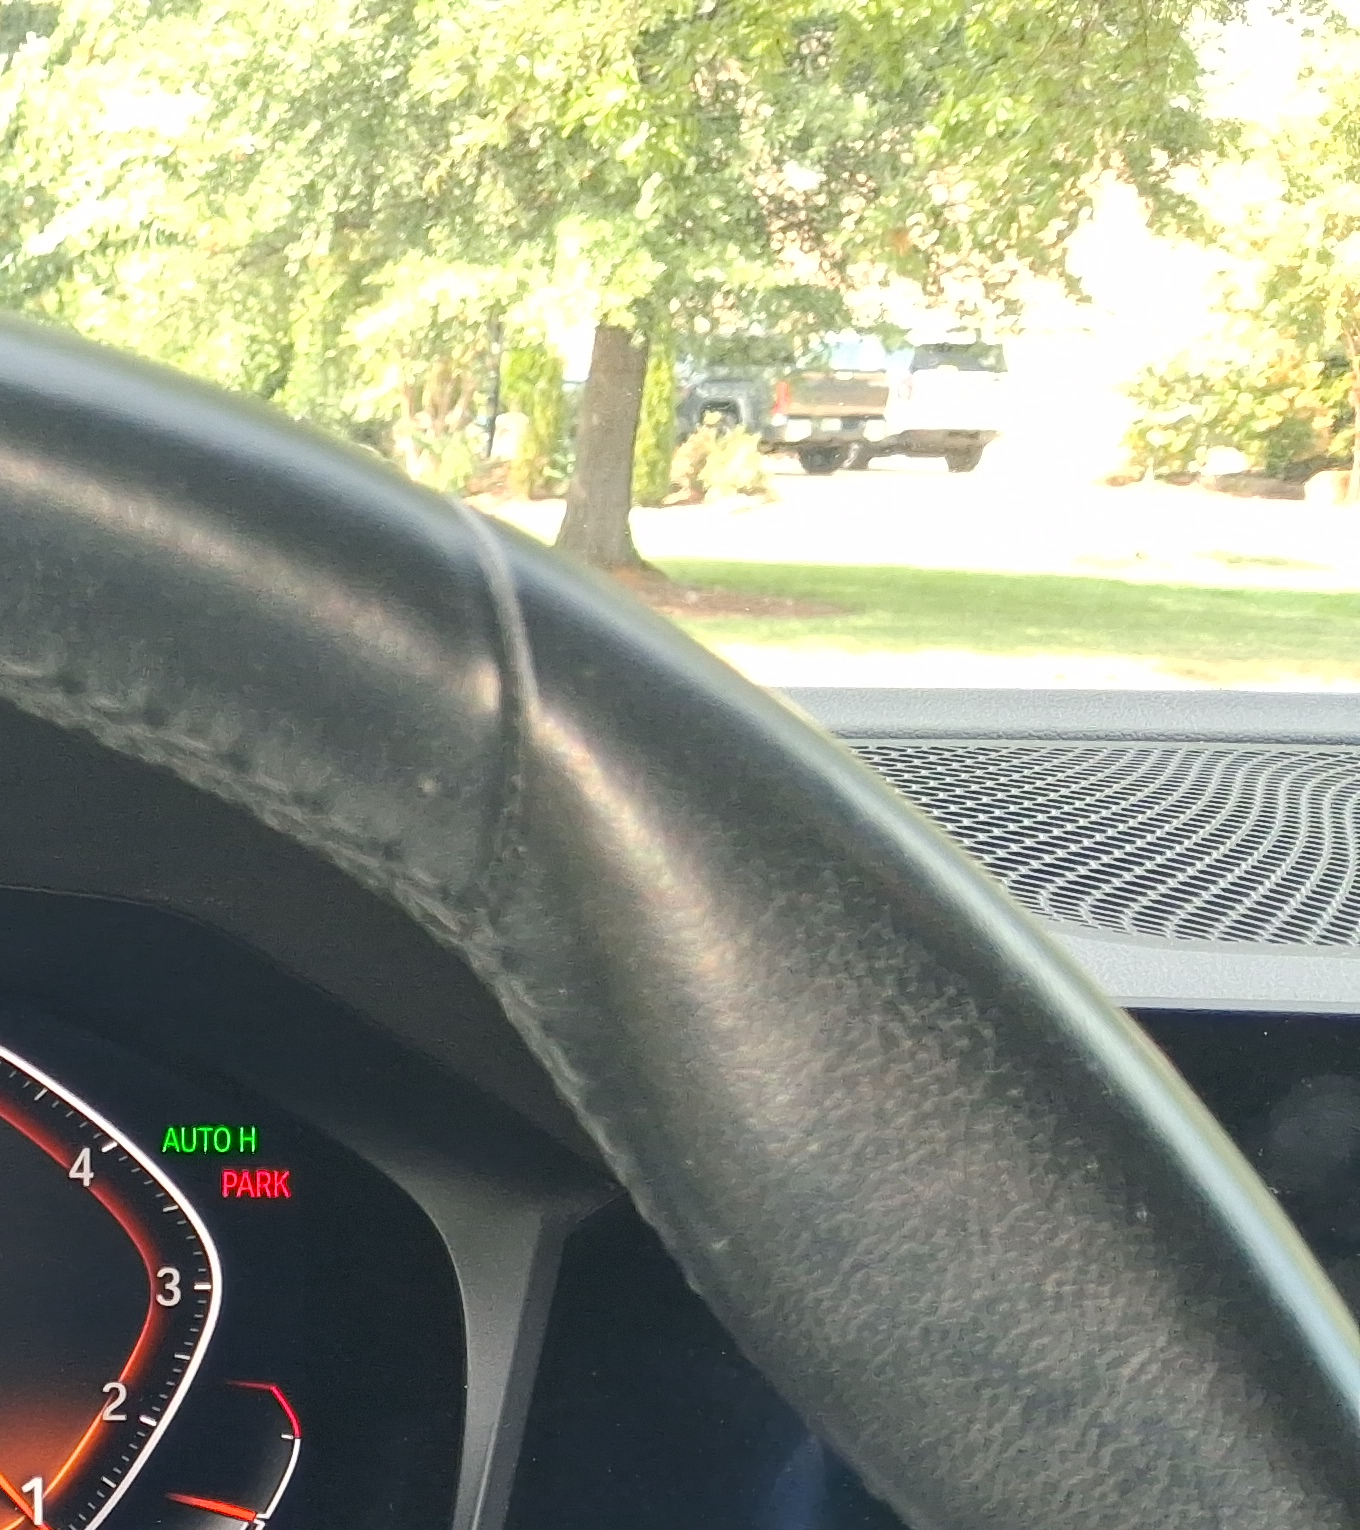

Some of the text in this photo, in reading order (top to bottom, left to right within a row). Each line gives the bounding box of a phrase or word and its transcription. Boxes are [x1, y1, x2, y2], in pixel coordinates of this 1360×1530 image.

[162, 1126, 257, 1153] AUTO H
[68, 1148, 94, 1188] 4
[221, 1170, 291, 1199] PARK
[156, 1267, 182, 1307] 3
[101, 1381, 127, 1422] 2
[21, 1477, 45, 1524] 1
